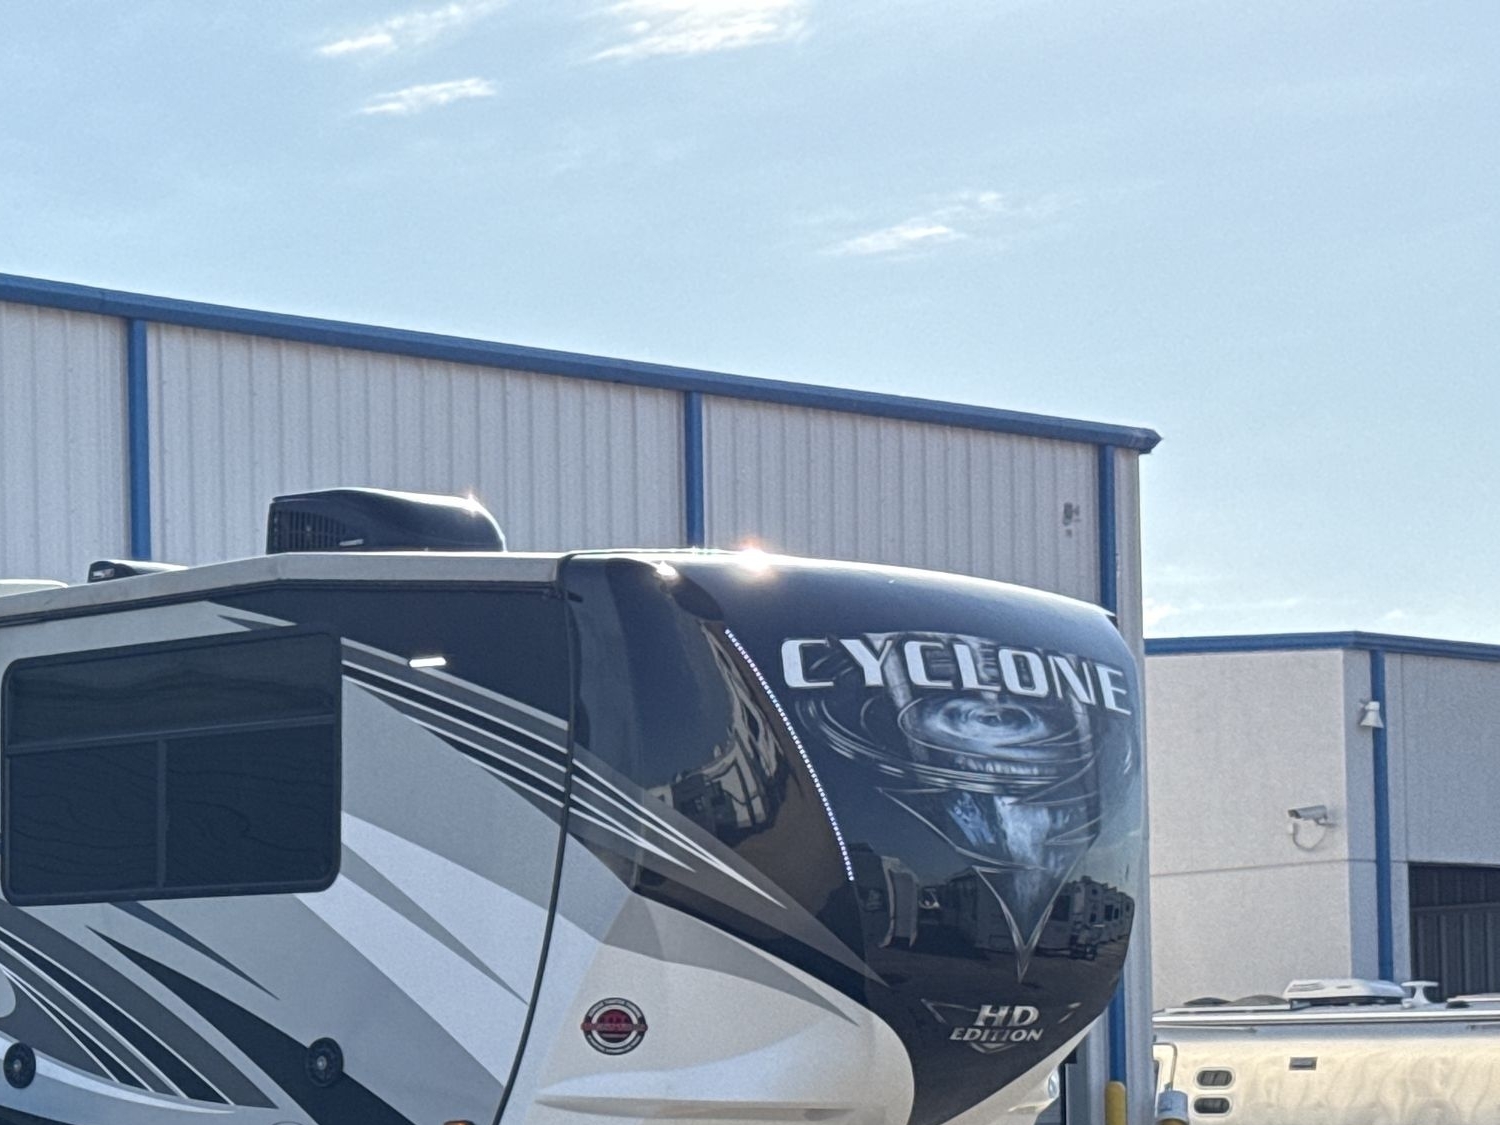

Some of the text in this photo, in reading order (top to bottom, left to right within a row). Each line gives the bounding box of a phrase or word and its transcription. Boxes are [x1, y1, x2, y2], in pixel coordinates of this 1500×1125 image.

[781, 637, 1132, 715] CYCLONE
[973, 1004, 1040, 1027] HD
[949, 1027, 1044, 1042] EDITION
